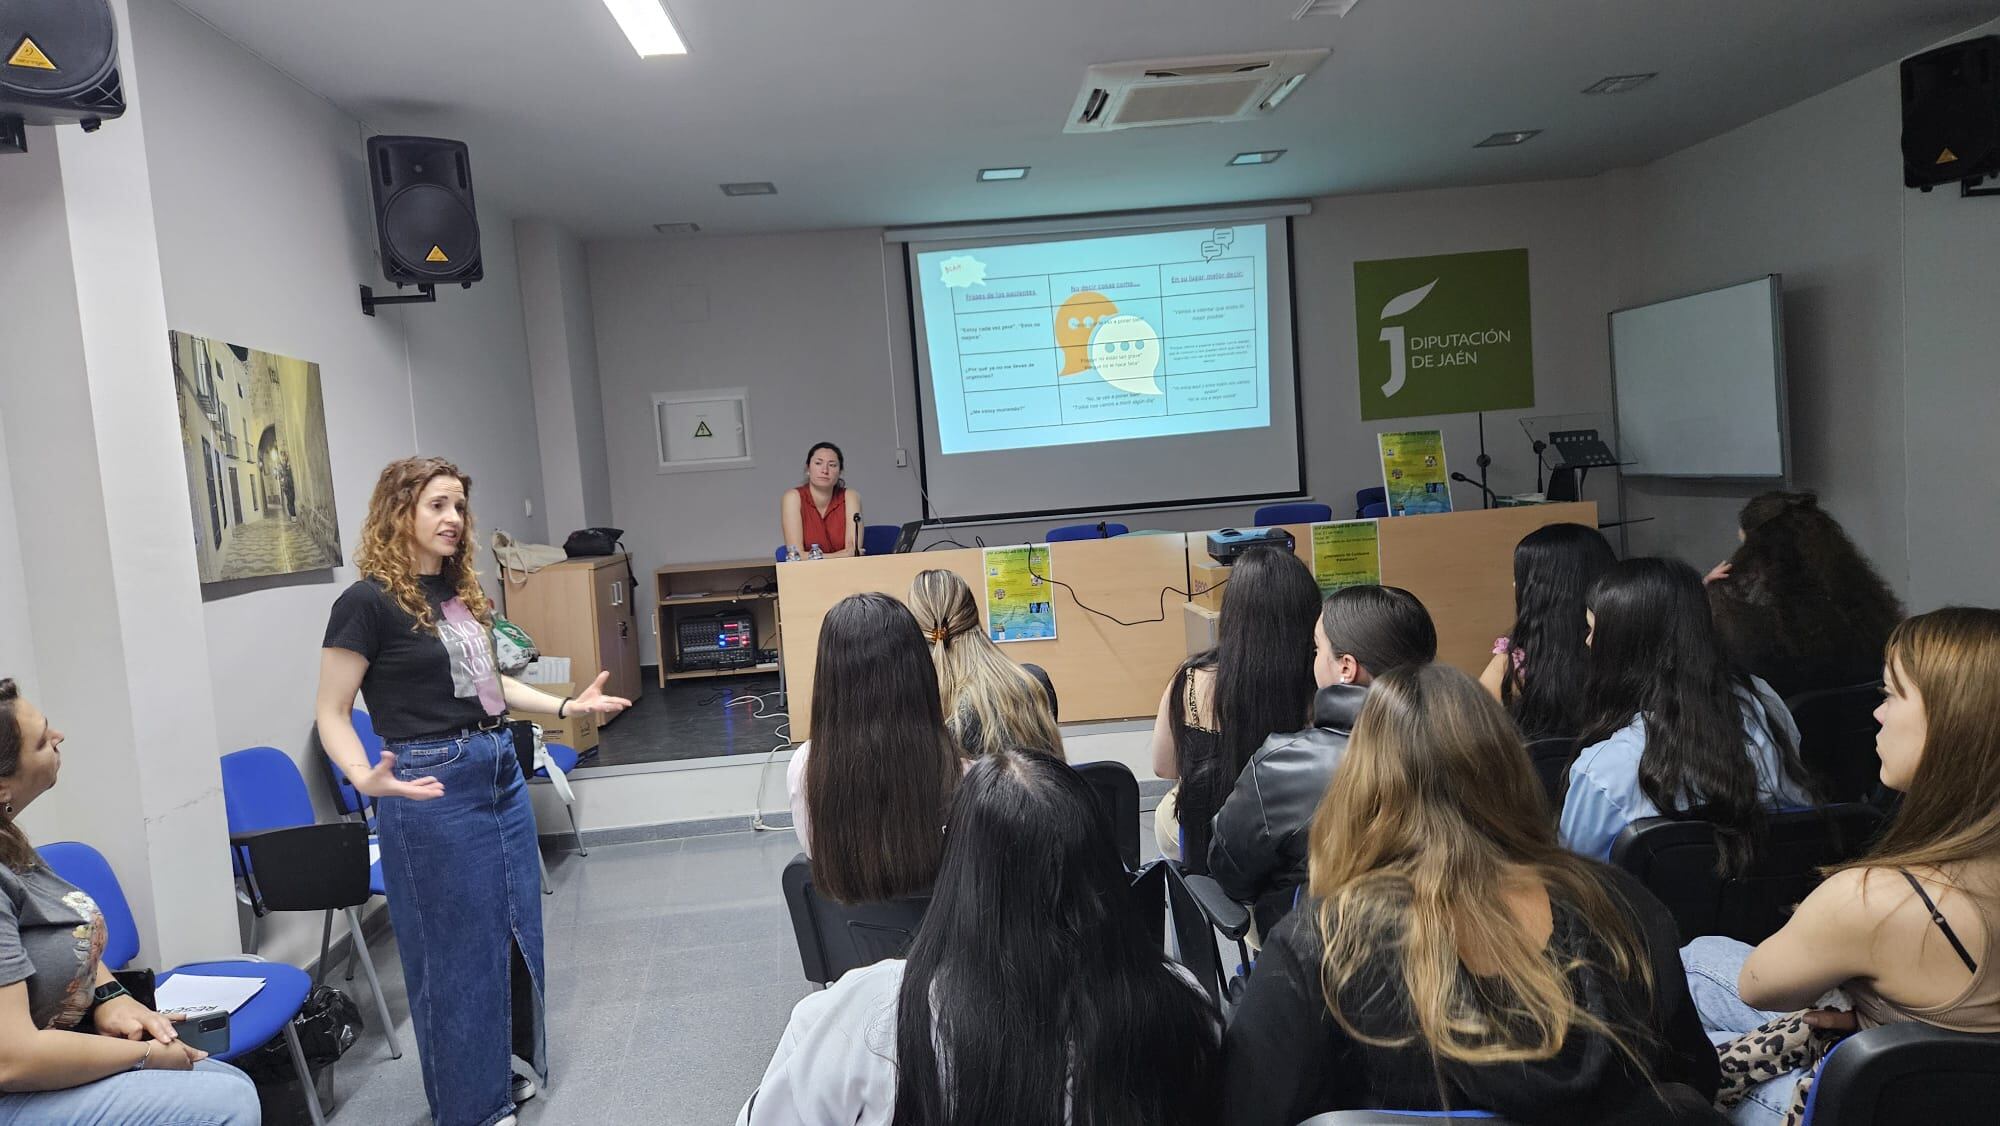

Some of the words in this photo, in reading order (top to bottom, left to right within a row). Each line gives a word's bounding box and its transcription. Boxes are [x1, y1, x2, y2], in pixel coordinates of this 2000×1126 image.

[1411, 328, 1512, 350] DIPUTACIÓN
[1412, 356, 1434, 368] DE
[1438, 351, 1478, 367] JAÉN
